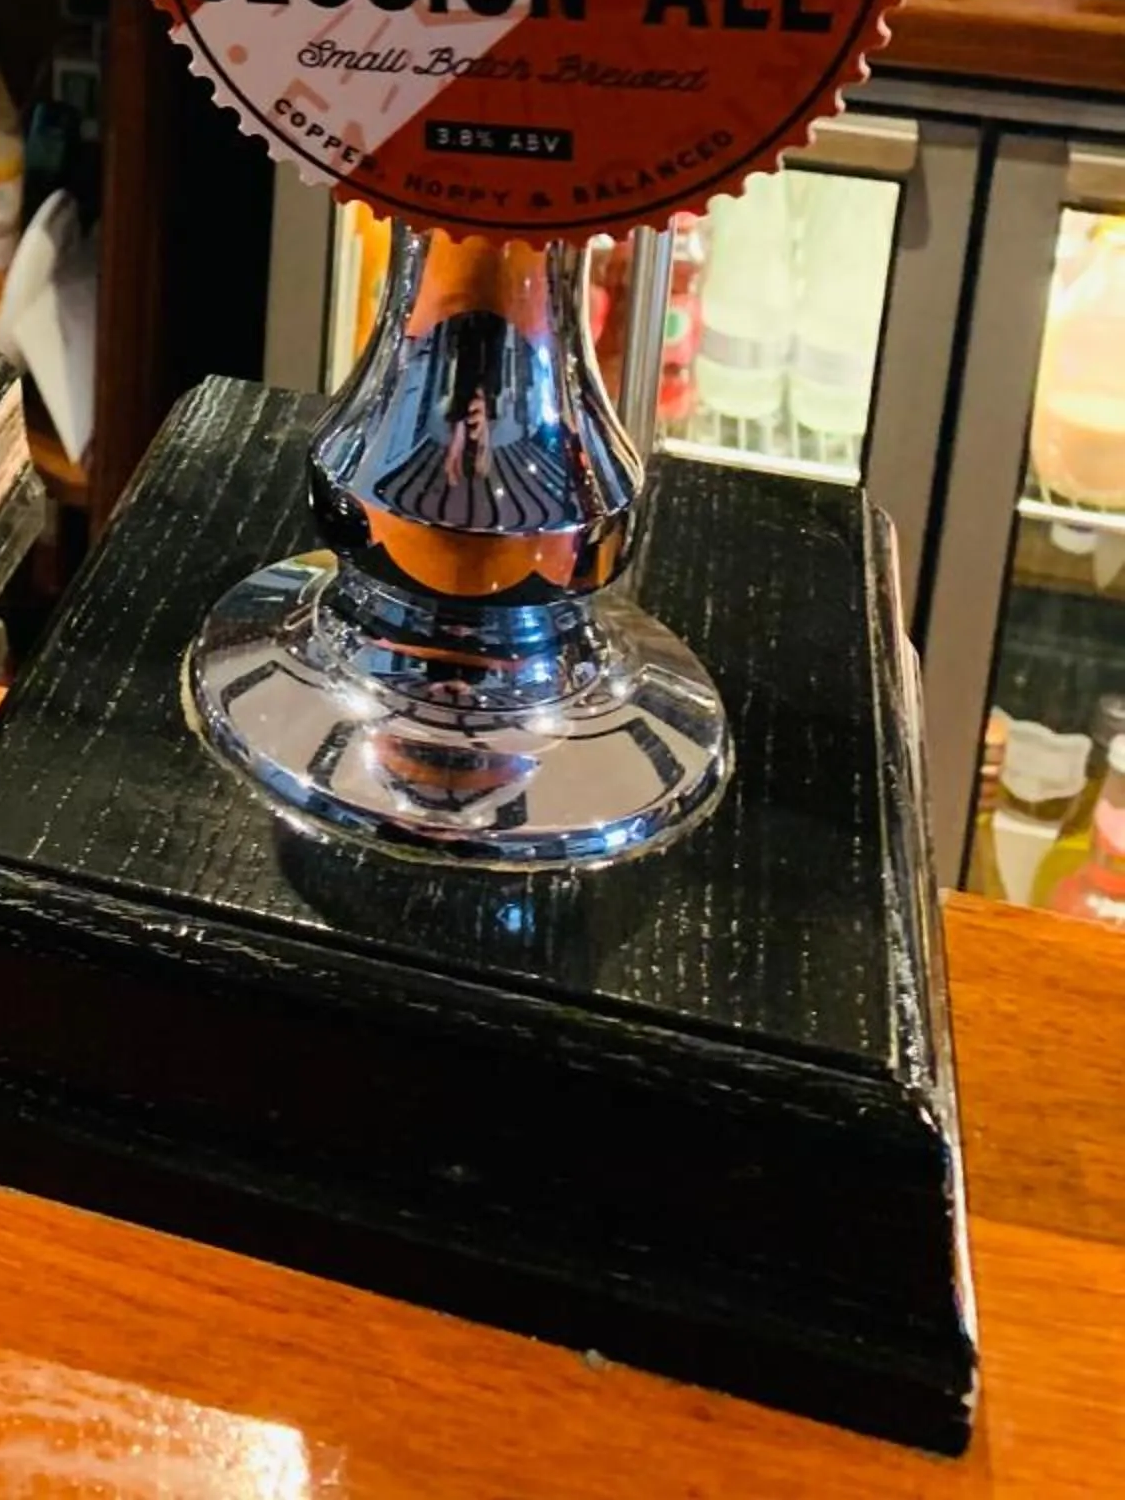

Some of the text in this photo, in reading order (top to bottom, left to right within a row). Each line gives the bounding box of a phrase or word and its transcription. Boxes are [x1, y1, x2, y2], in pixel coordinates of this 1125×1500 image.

[297, 40, 709, 93] Small Batch Brewed
[404, 172, 511, 207] HOPPY
[573, 128, 734, 205] BALANCED
[509, 134, 560, 152] ABV
